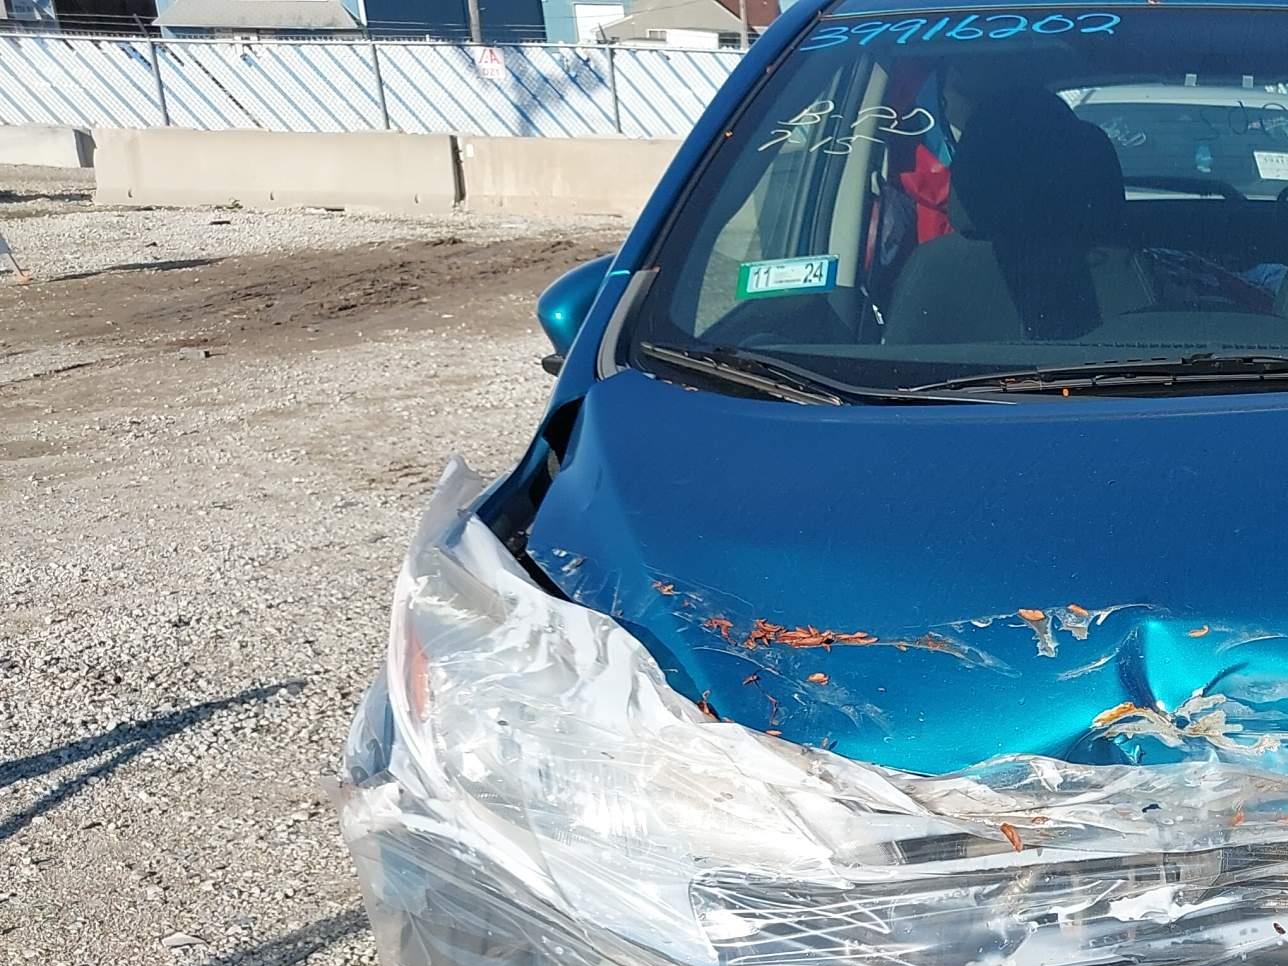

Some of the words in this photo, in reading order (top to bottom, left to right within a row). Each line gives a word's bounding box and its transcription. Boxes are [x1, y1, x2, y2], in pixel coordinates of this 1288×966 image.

[800, 13, 1121, 51] 39916202
[754, 266, 771, 289] 11
[803, 261, 825, 284] 24
